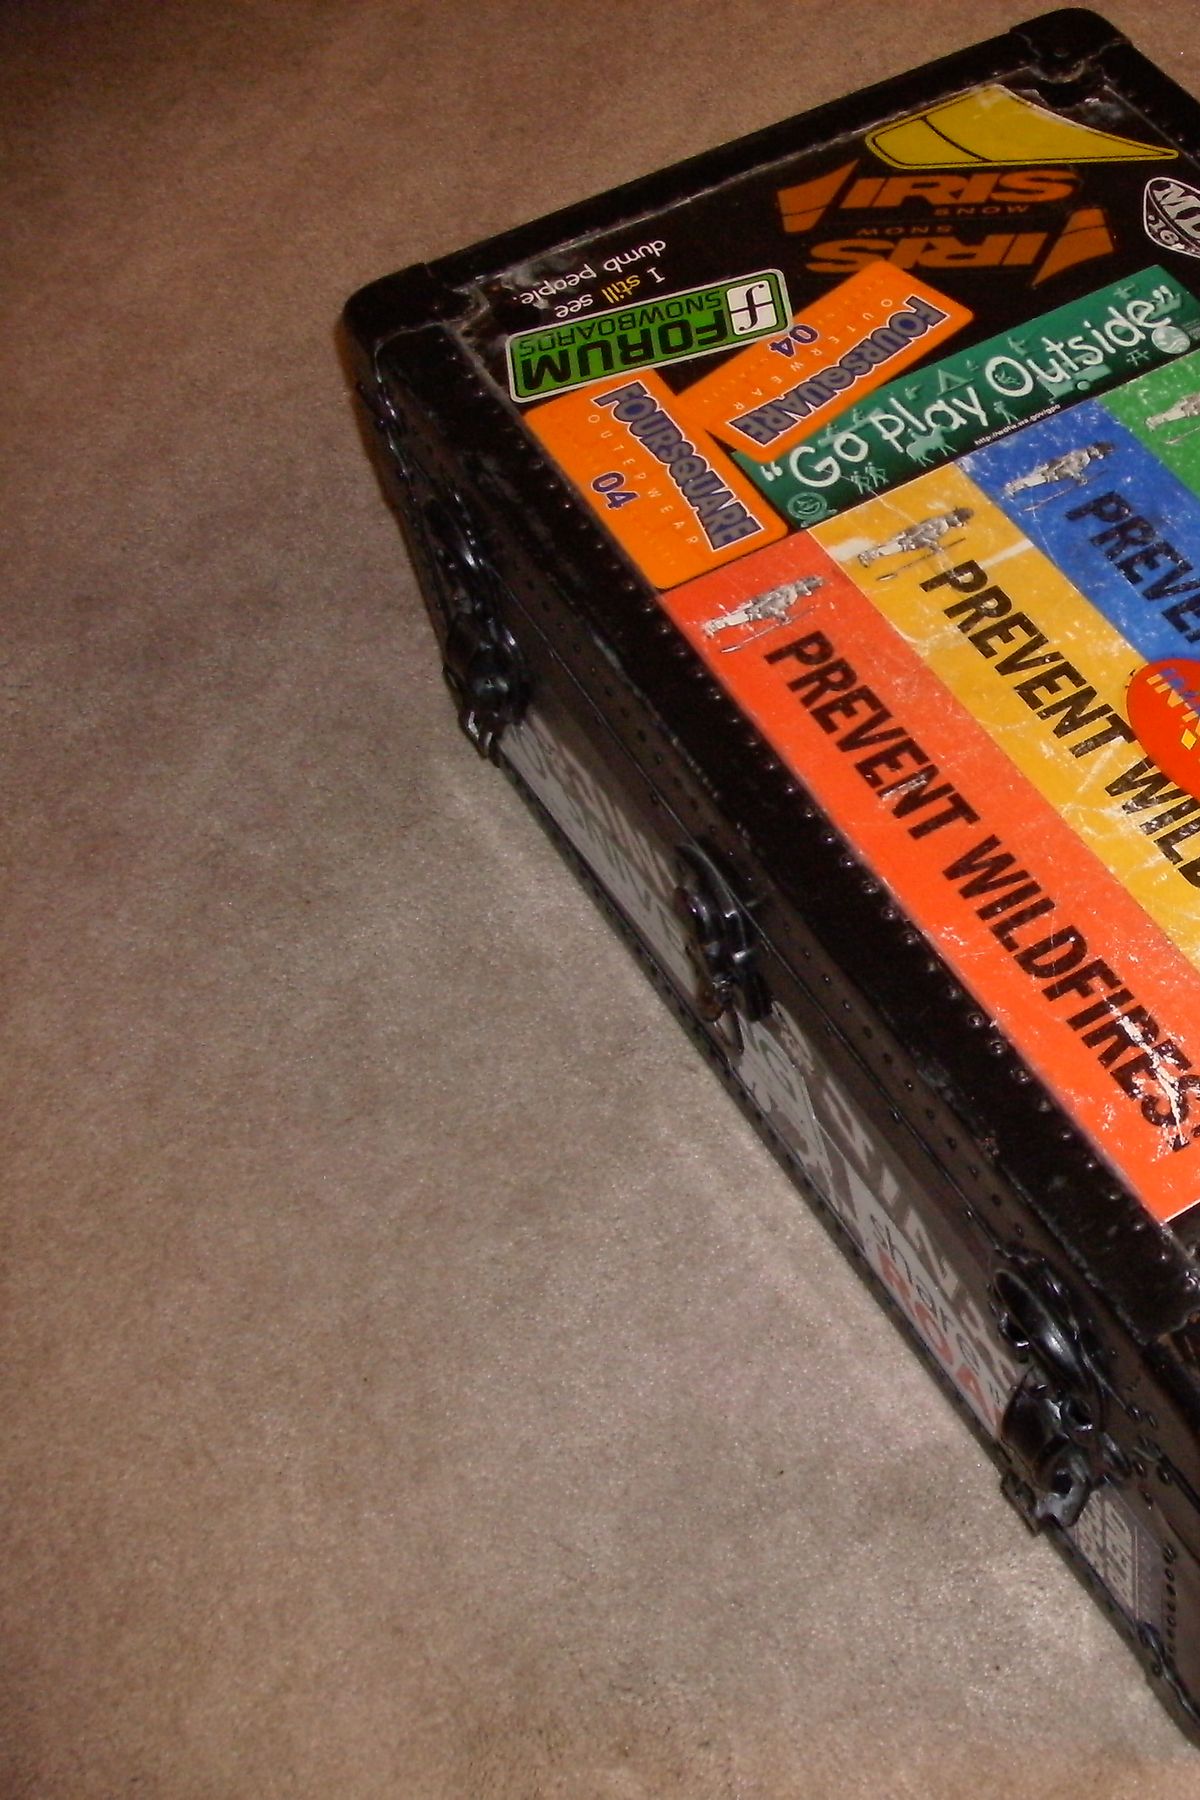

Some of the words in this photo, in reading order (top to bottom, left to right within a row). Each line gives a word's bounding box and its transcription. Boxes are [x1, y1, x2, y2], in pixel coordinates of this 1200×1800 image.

[934, 205, 1030, 216] SNOW
[512, 263, 598, 307] people.
[603, 239, 667, 272] dumb
[647, 267, 666, 283] I
[555, 293, 594, 318] see
[601, 274, 641, 304] still
[519, 290, 722, 357] SNOWBOARDS
[520, 309, 728, 391] FORUM
[769, 324, 820, 358] 04
[725, 295, 950, 447] FOURSQUARE
[867, 389, 989, 454] Play
[591, 379, 764, 552] FOURSQUARE
[591, 471, 640, 511] 04
[919, 559, 1137, 759] PREVENT
[764, 630, 980, 841] PREVENT
[870, 1213, 981, 1377] share
[878, 1248, 1002, 1436] ROA
